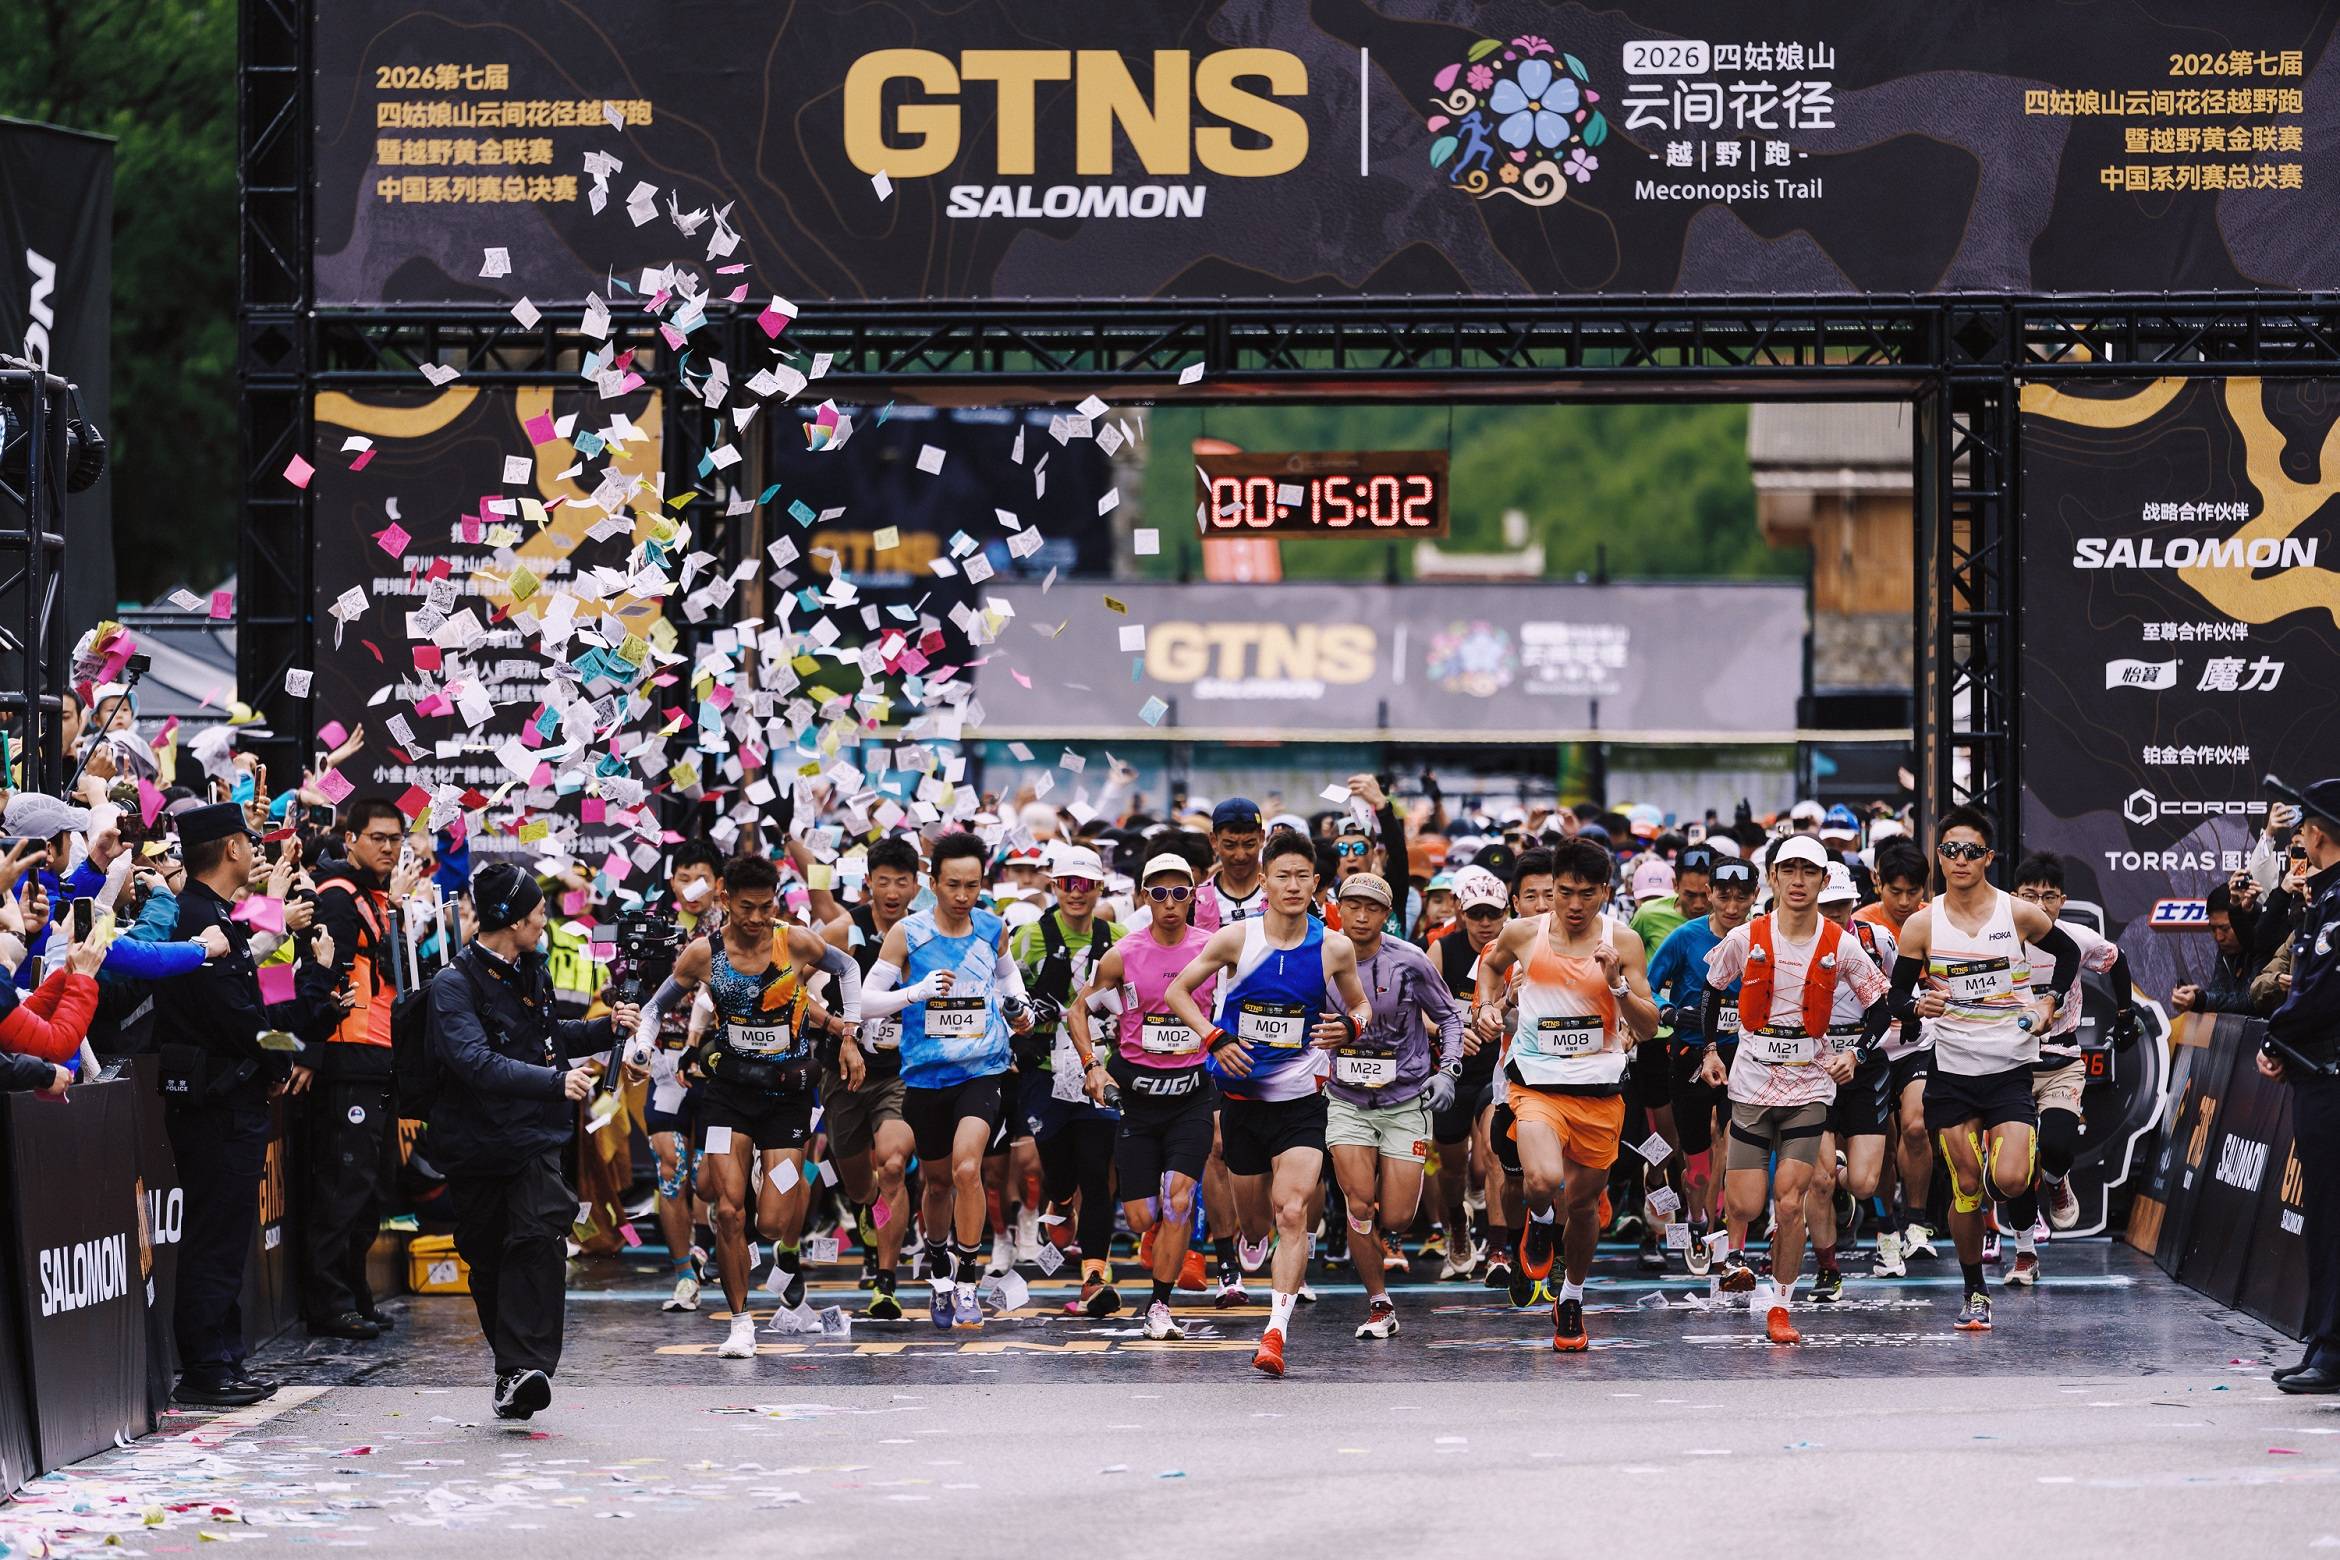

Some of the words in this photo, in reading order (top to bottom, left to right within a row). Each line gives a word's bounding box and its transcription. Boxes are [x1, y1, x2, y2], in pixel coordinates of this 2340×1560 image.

[1633, 46, 1700, 68] 2026
[1713, 41, 1835, 72] 四姑娘山
[2170, 51, 2303, 76] 2026第七届
[376, 64, 509, 90] 2026第七届
[844, 48, 1309, 178] GTNS
[1622, 80, 1836, 130] 云间花径
[2025, 89, 2303, 116] 四姑娘山云间花径越野跑
[377, 138, 553, 165] 暨越野黄金联赛
[2125, 126, 2303, 153] 暨越野黄金联赛
[377, 175, 577, 202] 中国系列赛总决赛
[2100, 164, 2303, 191] 中国系列赛总决赛
[946, 185, 1206, 218] SALOMON
[1635, 180, 1769, 203] Meconopsis
[1774, 178, 1823, 199] Trail
[2142, 502, 2250, 522] 战略合作伙伴
[2073, 537, 2318, 569] SALOMON
[2142, 621, 2249, 641] 至尊合作伙伴
[1144, 621, 1378, 684] GTNS
[2196, 655, 2285, 692] 魔力
[2142, 745, 2250, 765] 铂金合作伙伴
[2160, 801, 2268, 815] COROS
[2104, 850, 2216, 871] TORRAS
[2155, 903, 2210, 921] 士力
[1989, 931, 2012, 941] HOKA
[1965, 976, 1997, 991] M14
[939, 1014, 974, 1026] M04
[1255, 1020, 1288, 1034] M01
[741, 1030, 776, 1042] M06
[1157, 1030, 1190, 1042] M02
[1553, 1033, 1589, 1046] M08
[1768, 1042, 1799, 1054] M21
[1350, 1062, 1382, 1075] M22
[2216, 1133, 2269, 1192] SALOMON
[40, 1232, 128, 1317] SALOMON
